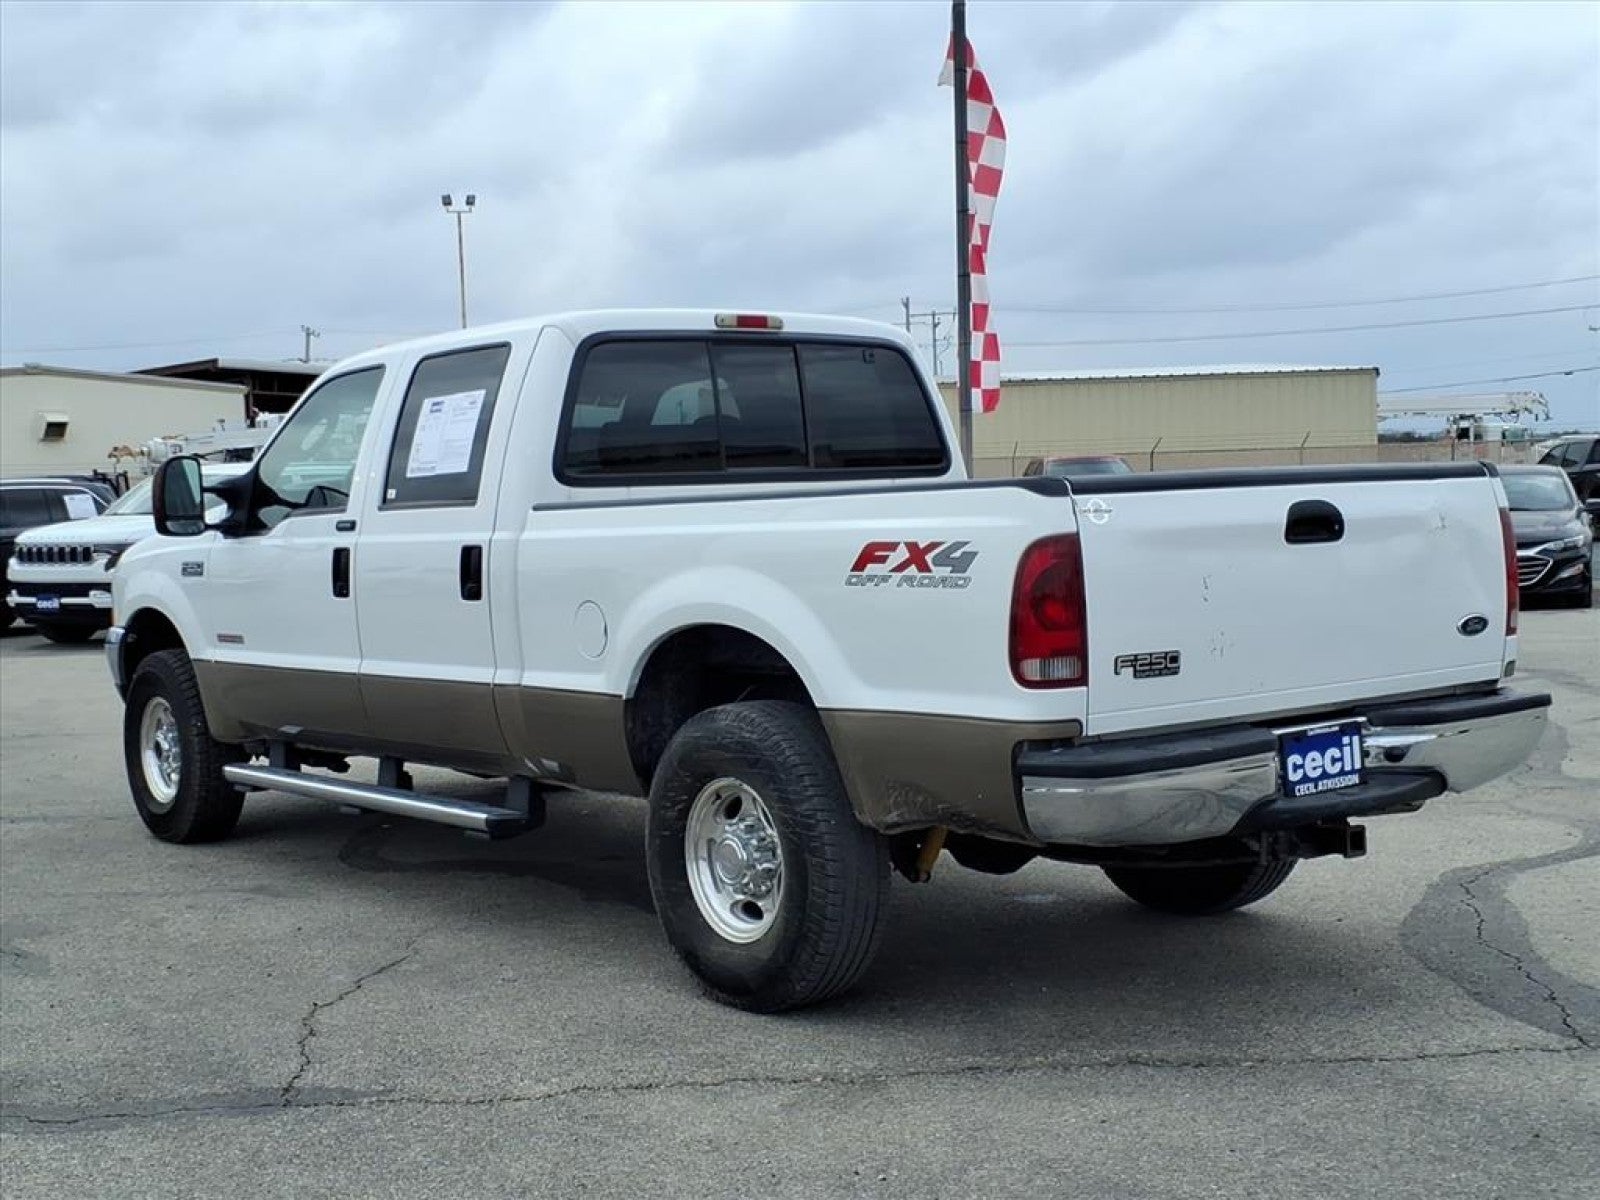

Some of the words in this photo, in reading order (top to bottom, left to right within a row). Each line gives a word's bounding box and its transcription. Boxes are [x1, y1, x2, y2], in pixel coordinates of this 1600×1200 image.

[850, 540, 979, 574] FX4
[845, 574, 893, 587] OFF
[896, 575, 973, 589] ROAD
[1114, 650, 1181, 675] F250
[1287, 735, 1362, 782] cecil
